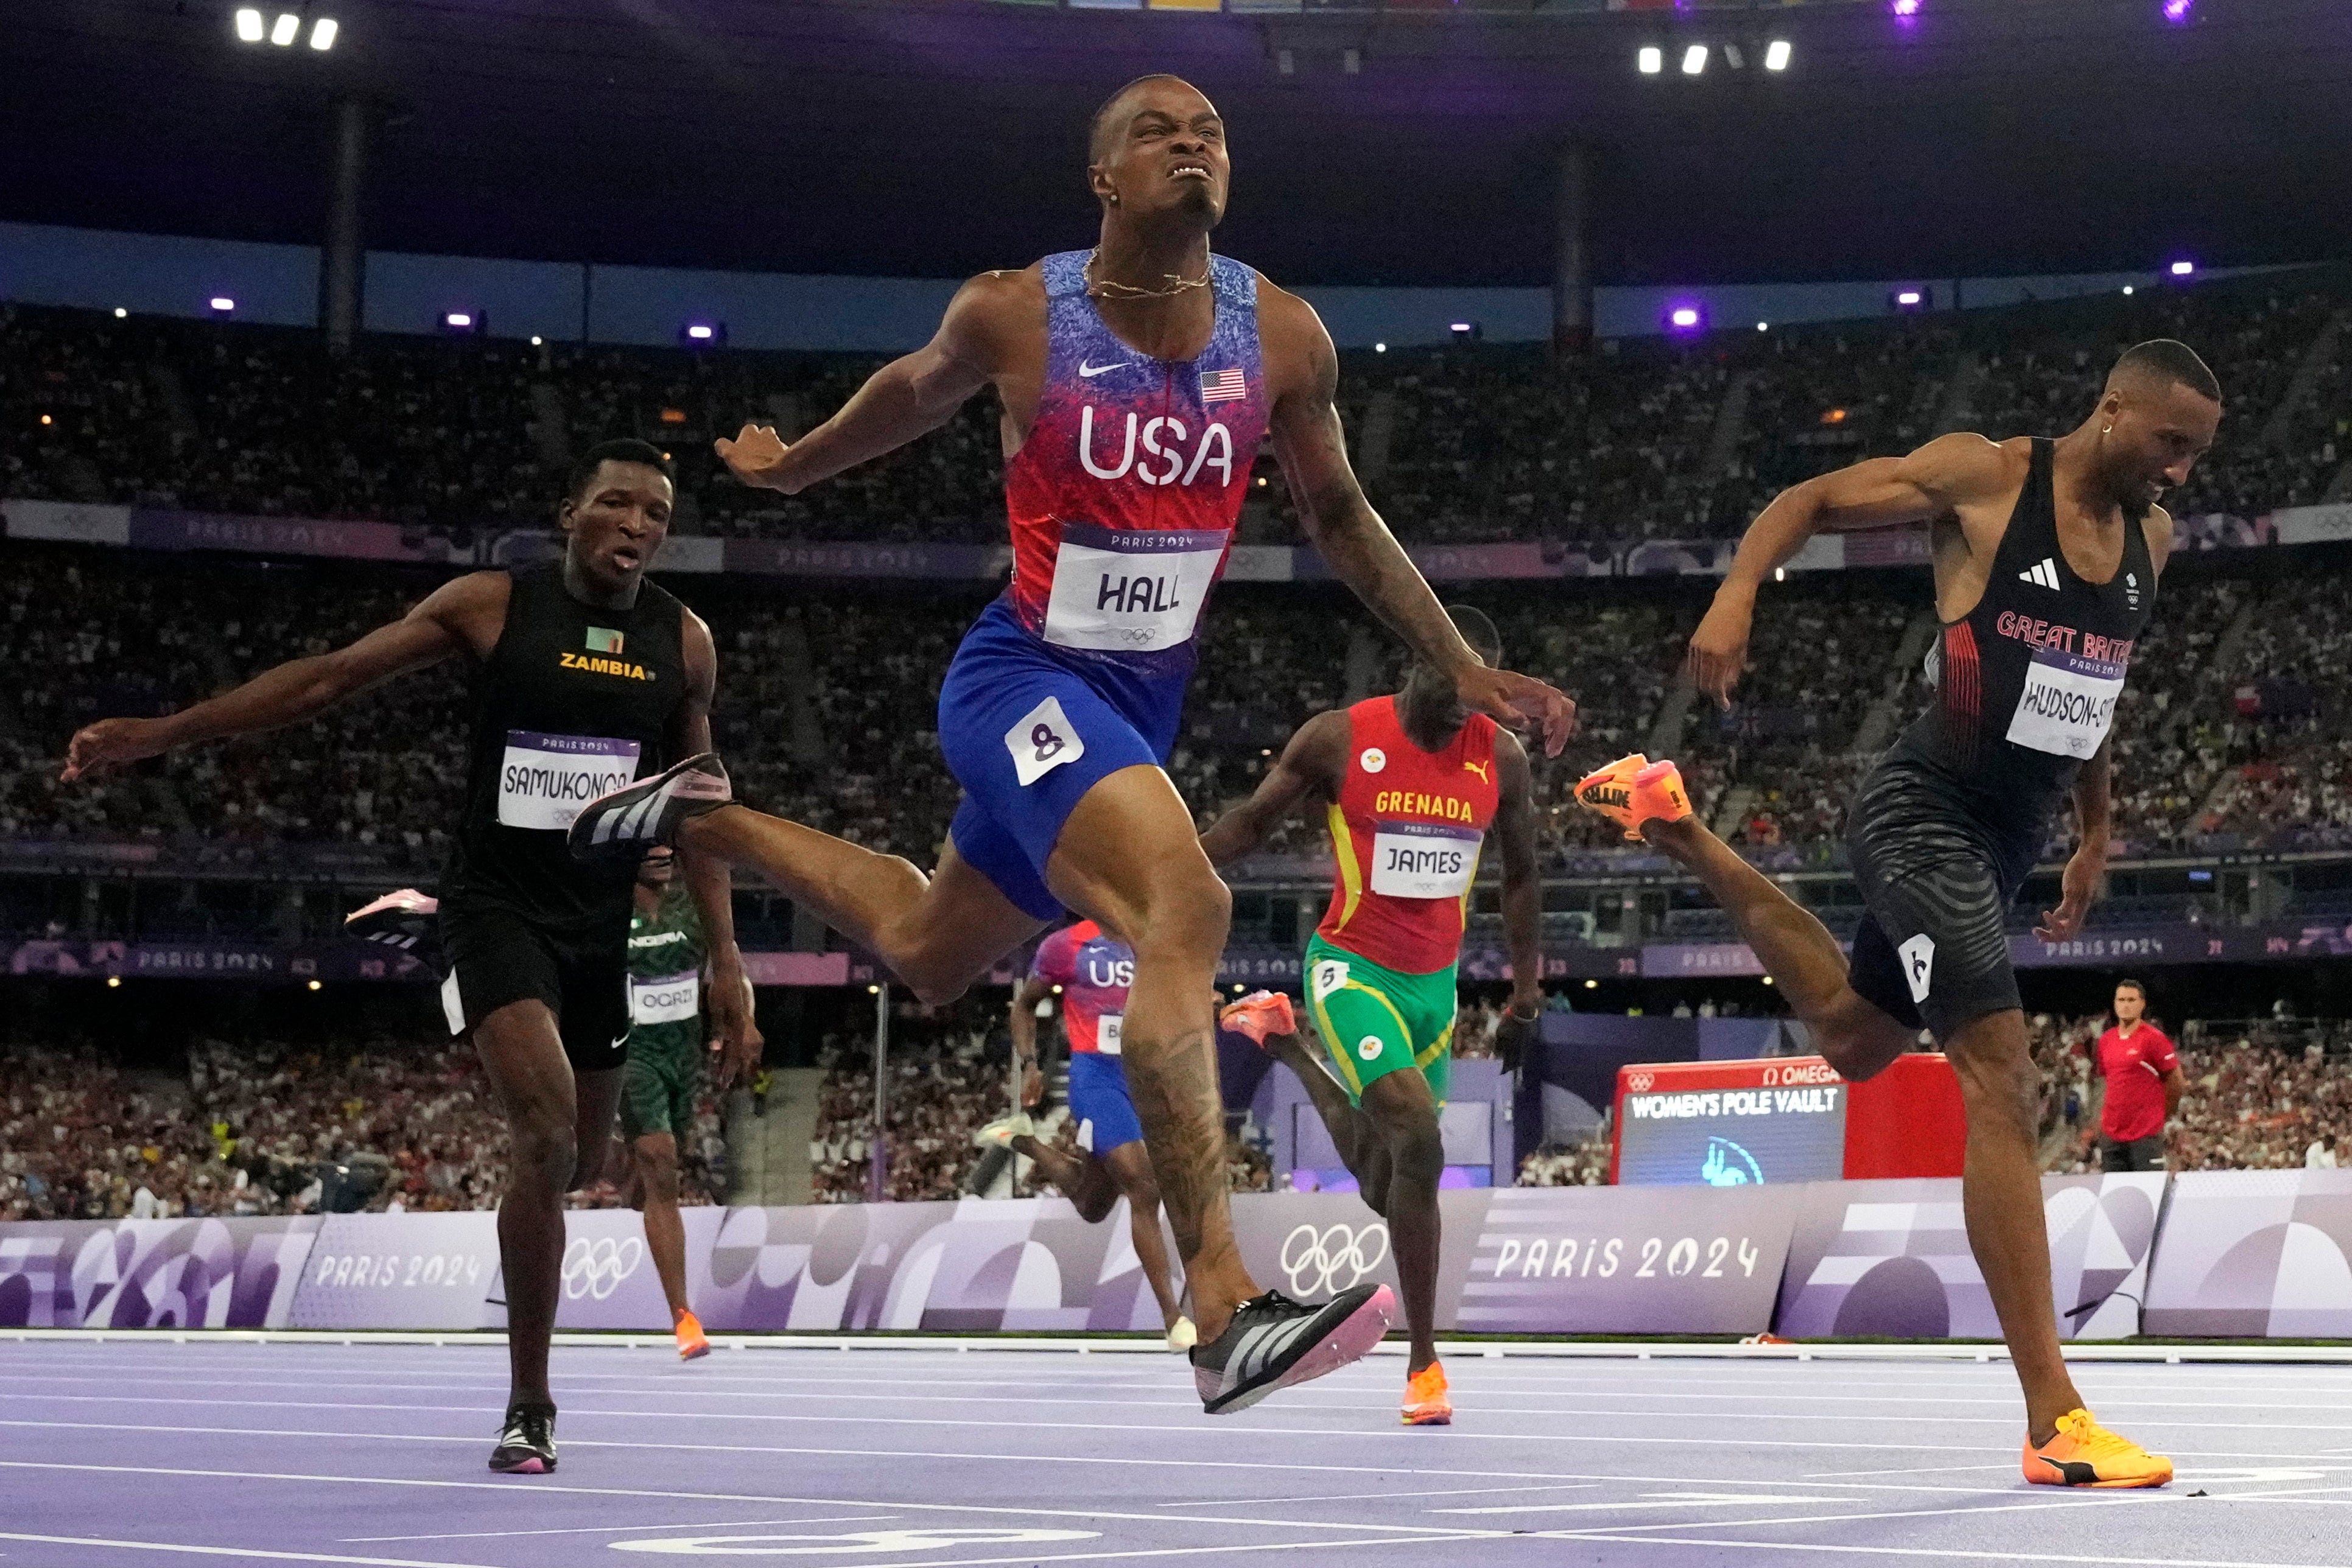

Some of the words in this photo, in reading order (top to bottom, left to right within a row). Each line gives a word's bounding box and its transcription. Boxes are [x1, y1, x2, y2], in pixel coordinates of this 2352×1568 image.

[1079, 405, 1232, 487] USA
[1111, 535, 1154, 547] PARIS
[1159, 536, 1193, 547] 2024
[1097, 573, 1179, 612] HALL
[1997, 611, 2076, 653] GREAT
[560, 653, 646, 681] ZAMBIA
[2069, 658, 2100, 673] PARIS
[542, 738, 577, 750] PARIS
[580, 741, 609, 751] 2024
[1031, 723, 1065, 761] 8
[1375, 791, 1472, 823] GRENADA
[1387, 848, 1462, 873] JAMES
[2045, 941, 2105, 956] PARIS
[1322, 967, 1335, 988] 5
[1782, 1065, 1841, 1085] OMEGA
[1632, 1093, 1719, 1119] WOMEN'S
[1722, 1091, 1772, 1116] POLE
[1774, 1088, 1838, 1113] VAULT
[316, 1255, 399, 1288] PARIS
[403, 1255, 483, 1287] 2024
[1494, 1237, 1624, 1278] PARIS
[1634, 1236, 1759, 1278] 2024
